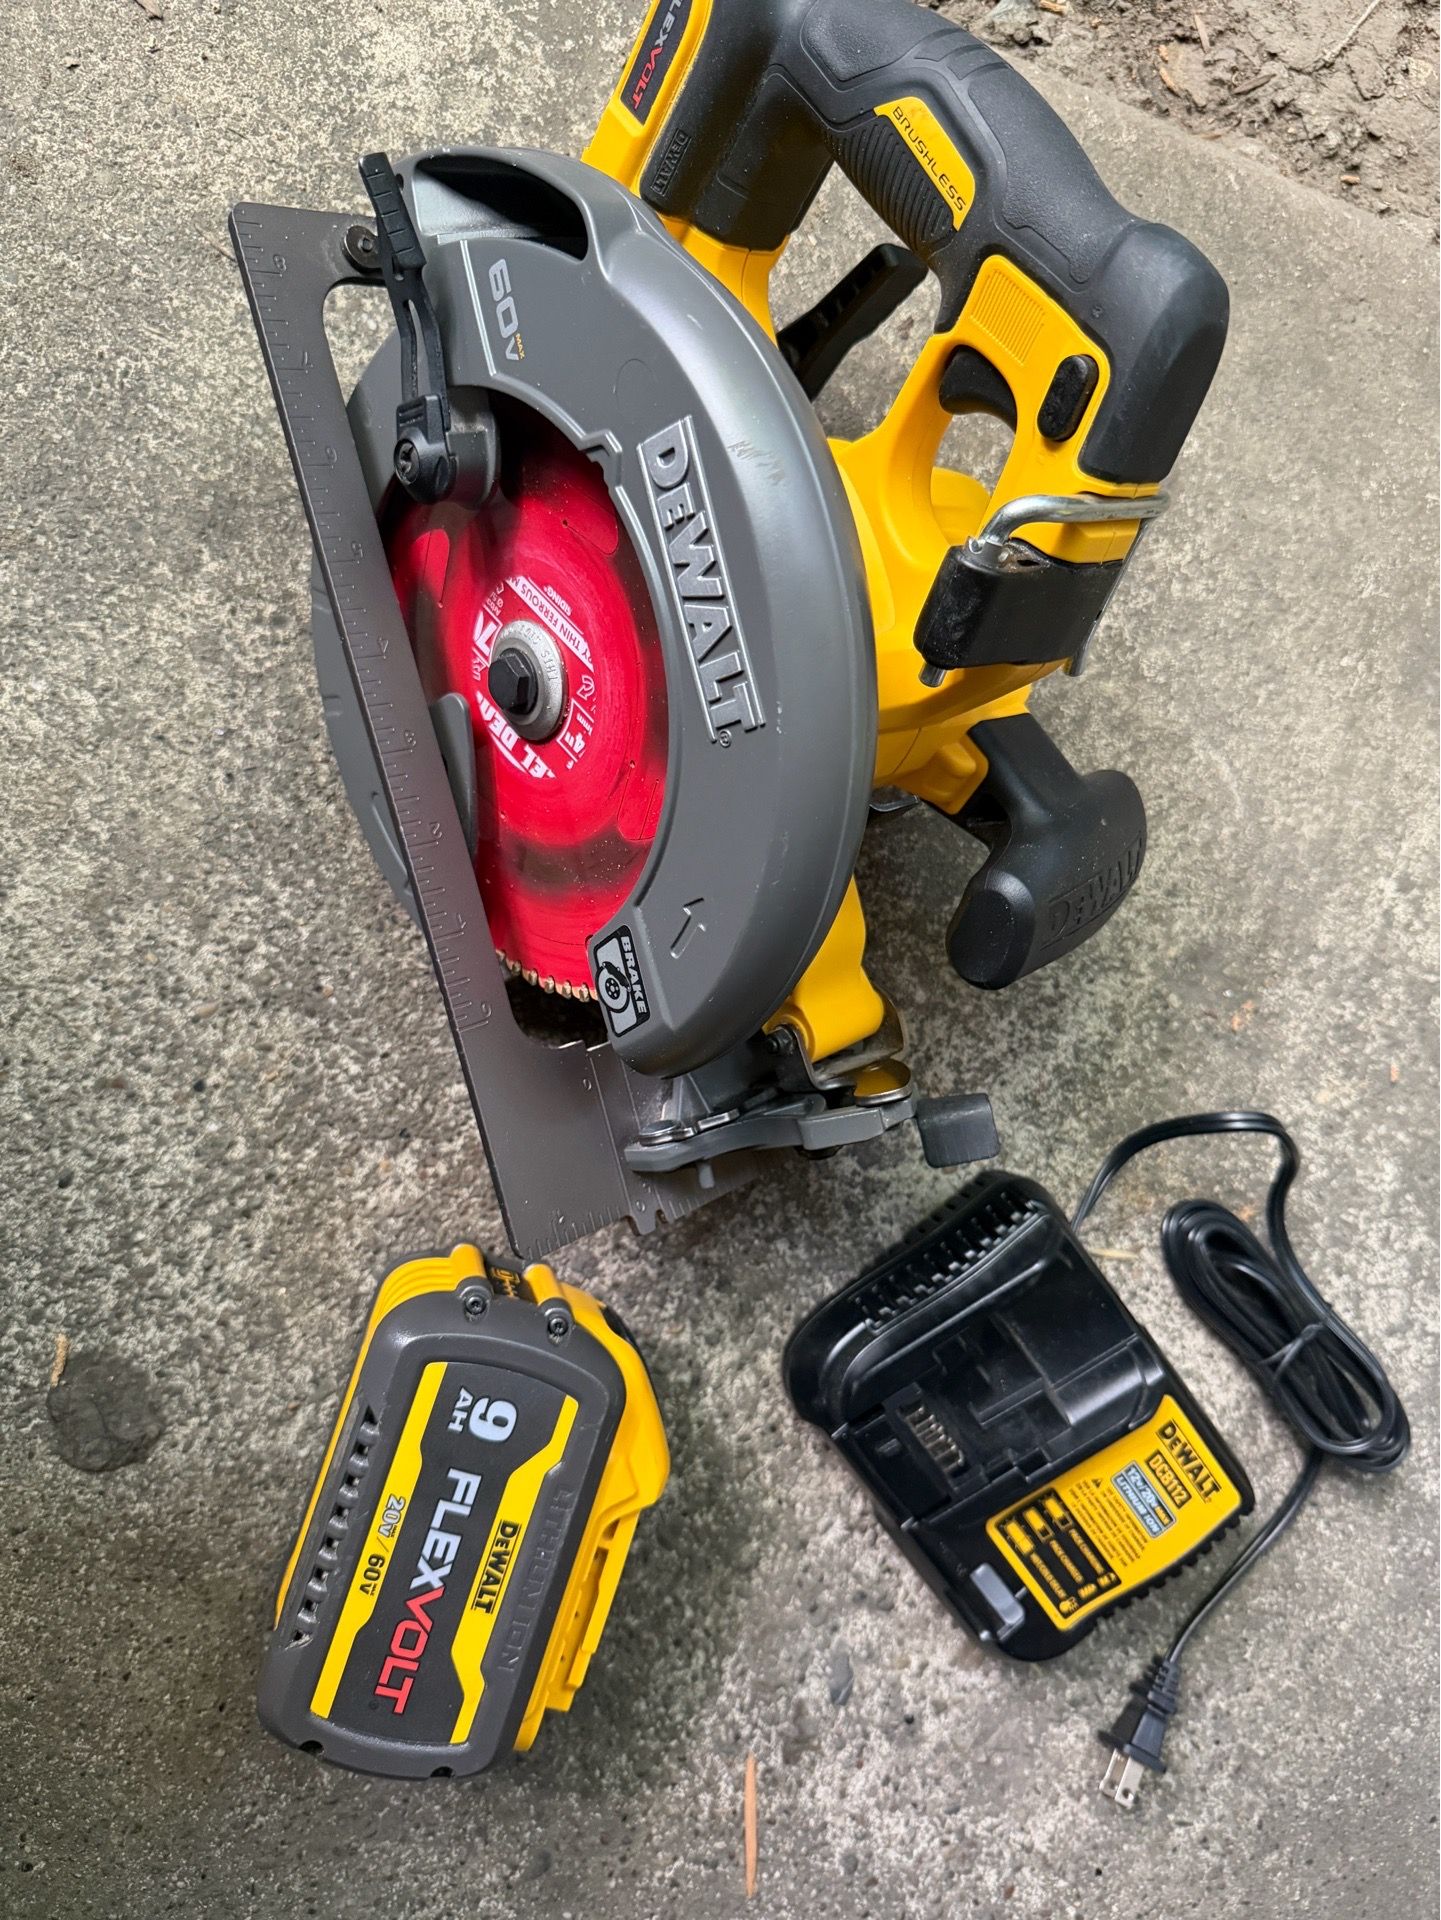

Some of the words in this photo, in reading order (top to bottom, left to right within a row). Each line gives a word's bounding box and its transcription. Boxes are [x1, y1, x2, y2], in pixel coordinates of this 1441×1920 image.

[632, 0, 684, 110] LEXVOLT
[892, 105, 967, 212] BRUSHLESS
[488, 259, 523, 361] 60V
[520, 583, 559, 628] FERROUS
[639, 418, 760, 734] DEWALT
[540, 649, 560, 682] THIS
[560, 624, 581, 651] THIN
[620, 936, 647, 1013] BRAKE
[446, 1386, 474, 1435] AH
[467, 1397, 519, 1444] 9
[1147, 1453, 1189, 1507] DCB112
[1156, 1418, 1221, 1502] DEWALT
[1115, 1476, 1147, 1515] LITHIUM
[1143, 1514, 1161, 1534] ION
[374, 1466, 483, 1714] FLEXVOLT
[471, 1518, 521, 1615] DEWALT
